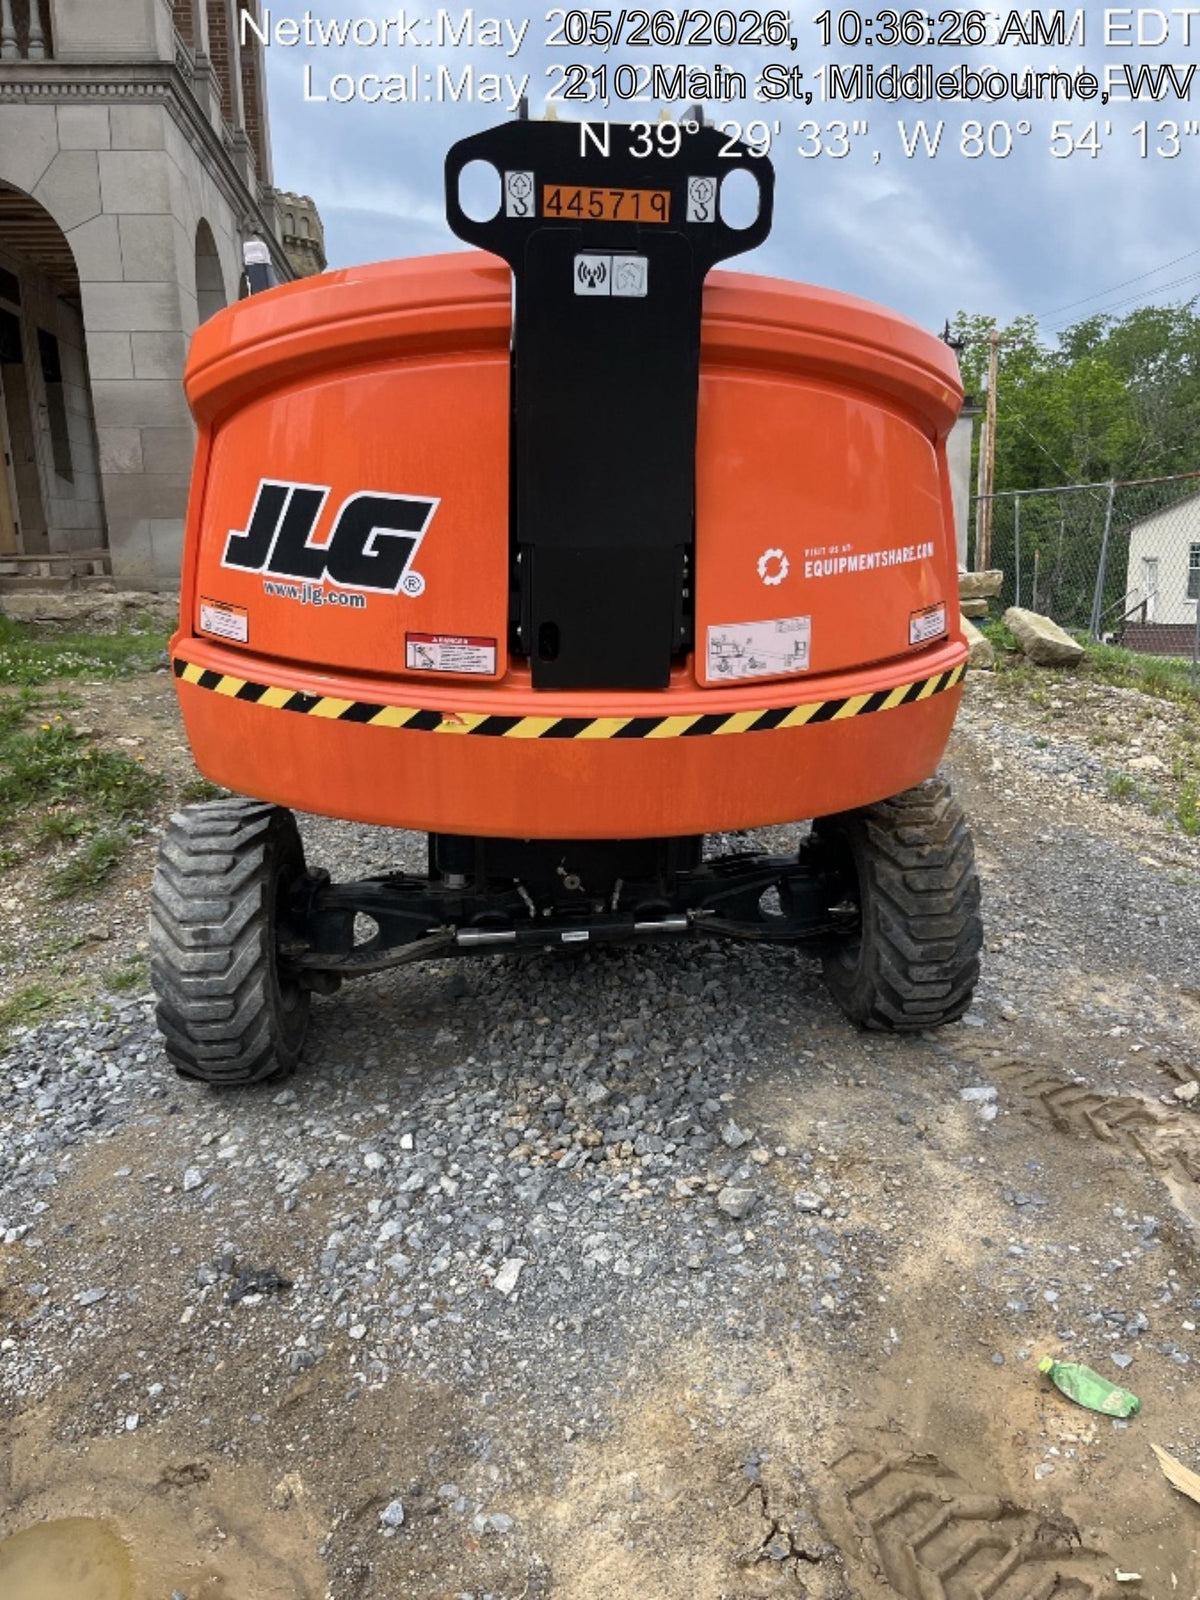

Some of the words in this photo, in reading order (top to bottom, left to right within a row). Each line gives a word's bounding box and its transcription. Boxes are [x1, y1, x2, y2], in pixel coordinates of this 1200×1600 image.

[546, 188, 667, 221] 445719
[220, 478, 441, 595] JLG
[804, 541, 935, 578] EQUIPMENTSHARE.COM
[263, 581, 367, 609] www.jlg.com
